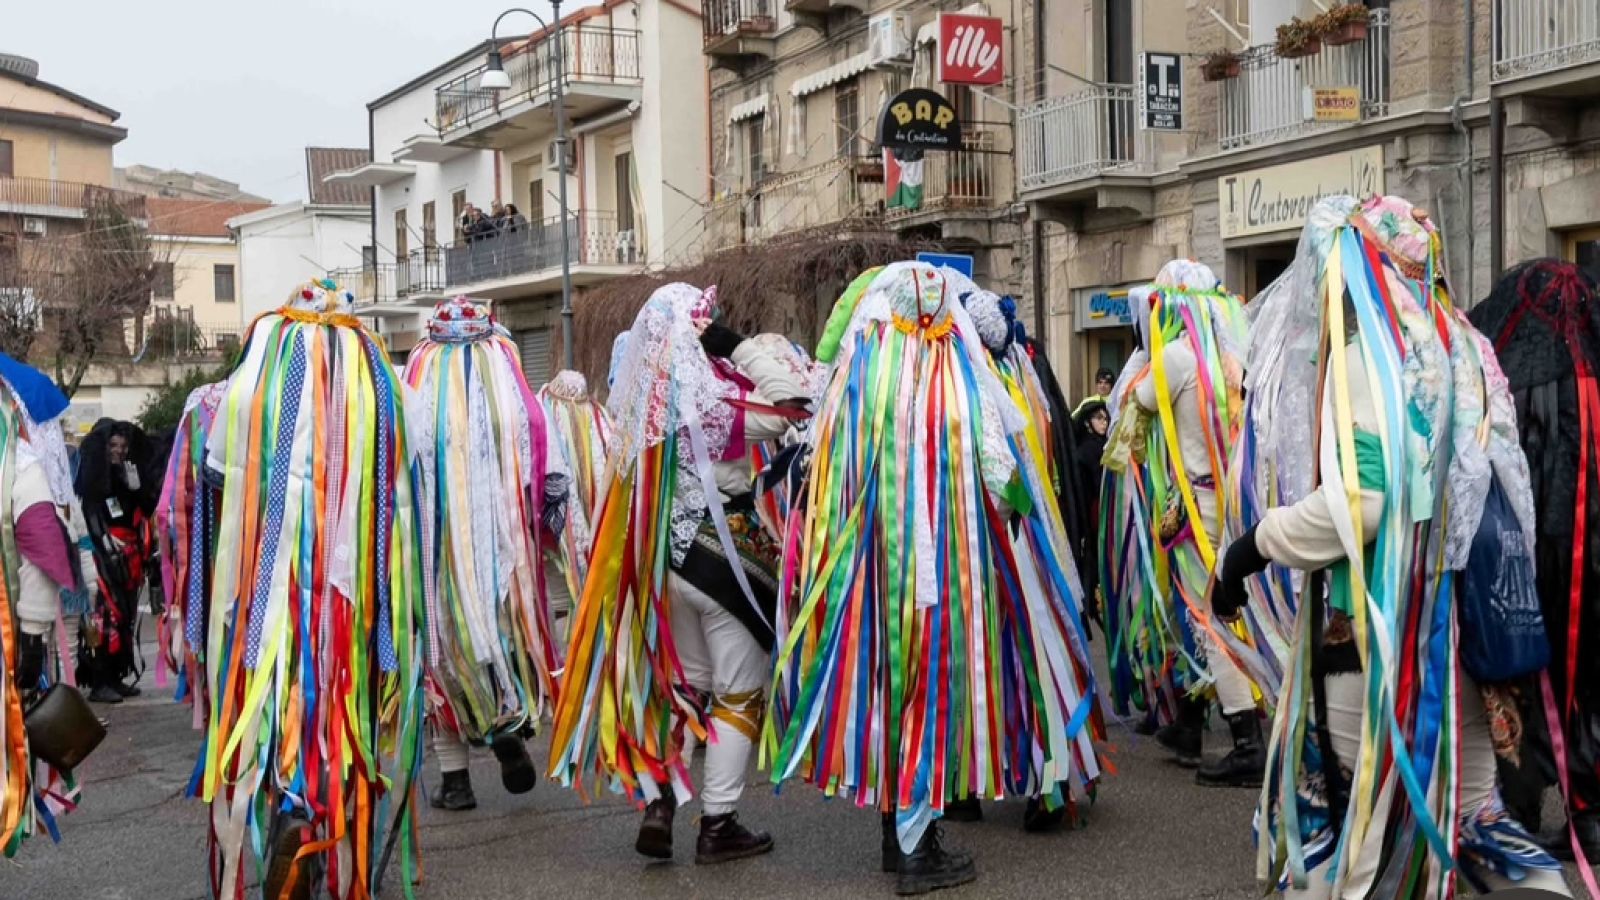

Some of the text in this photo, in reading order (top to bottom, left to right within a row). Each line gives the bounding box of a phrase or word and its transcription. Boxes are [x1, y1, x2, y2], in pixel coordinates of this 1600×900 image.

[946, 25, 1000, 78] illy
[1151, 55, 1175, 95] T
[891, 100, 954, 129] BAR
[1225, 178, 1237, 213] T
